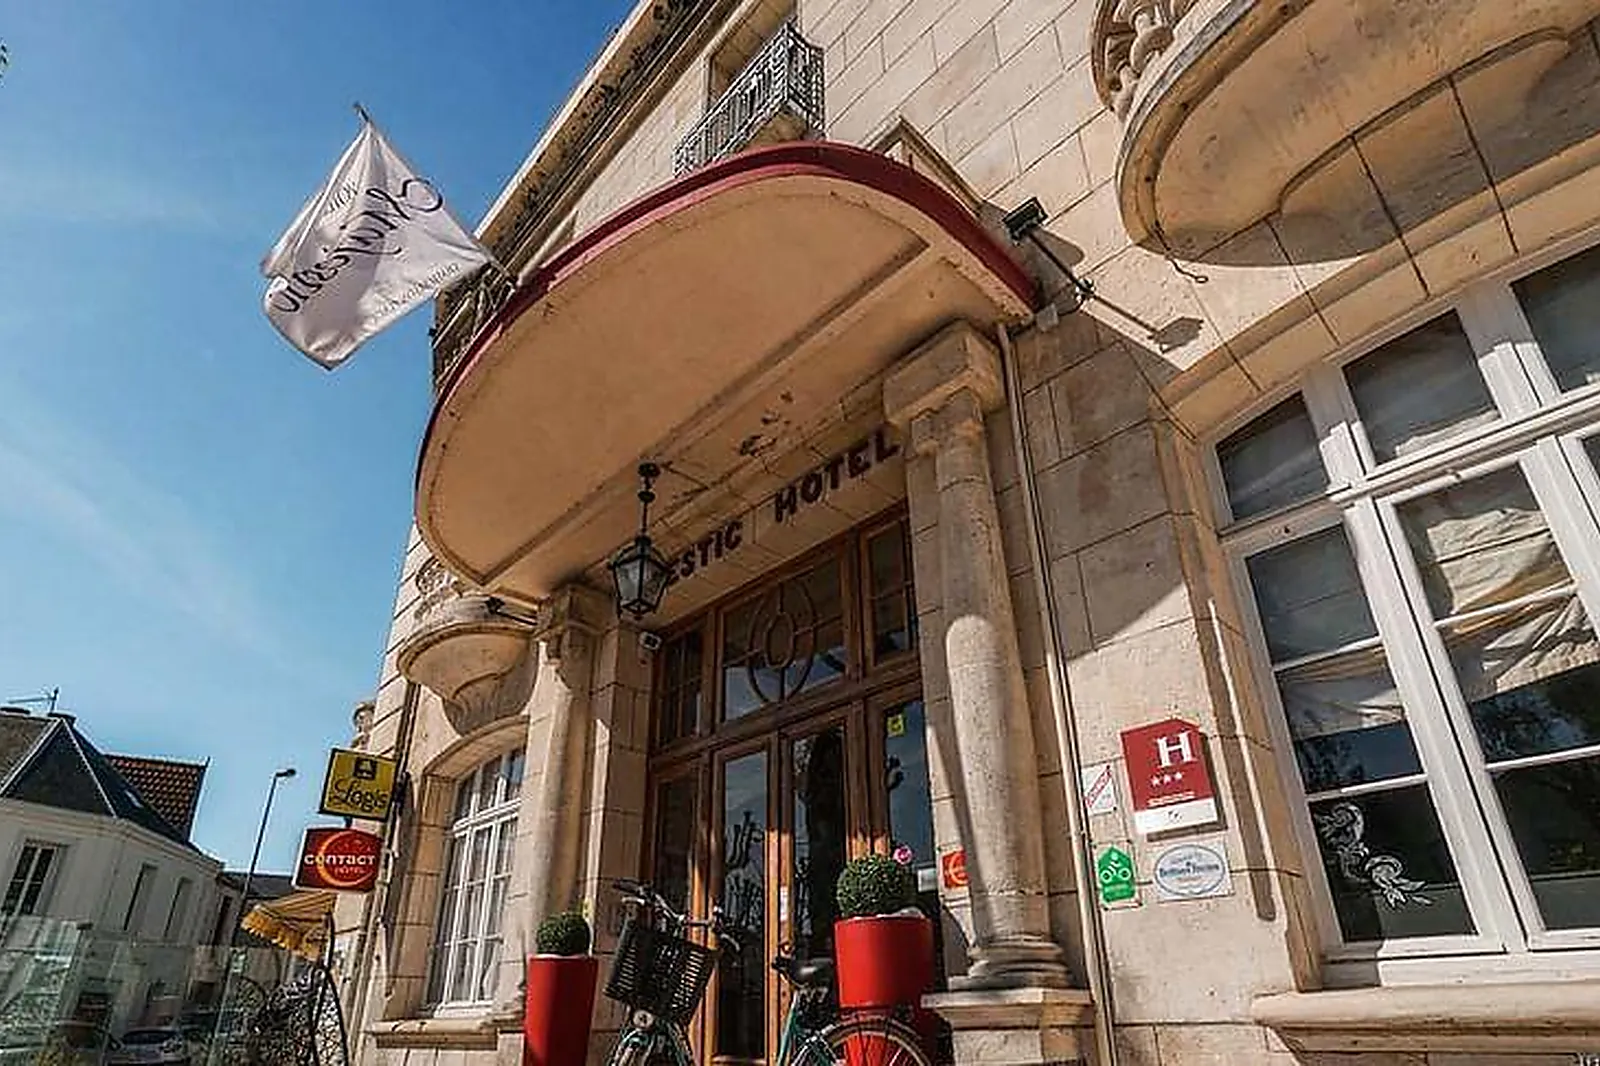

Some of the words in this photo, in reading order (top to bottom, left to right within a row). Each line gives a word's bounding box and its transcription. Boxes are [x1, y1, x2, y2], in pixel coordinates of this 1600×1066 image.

[774, 424, 901, 523] HOTEL
[1155, 729, 1199, 769] H
[331, 778, 388, 812] Logis
